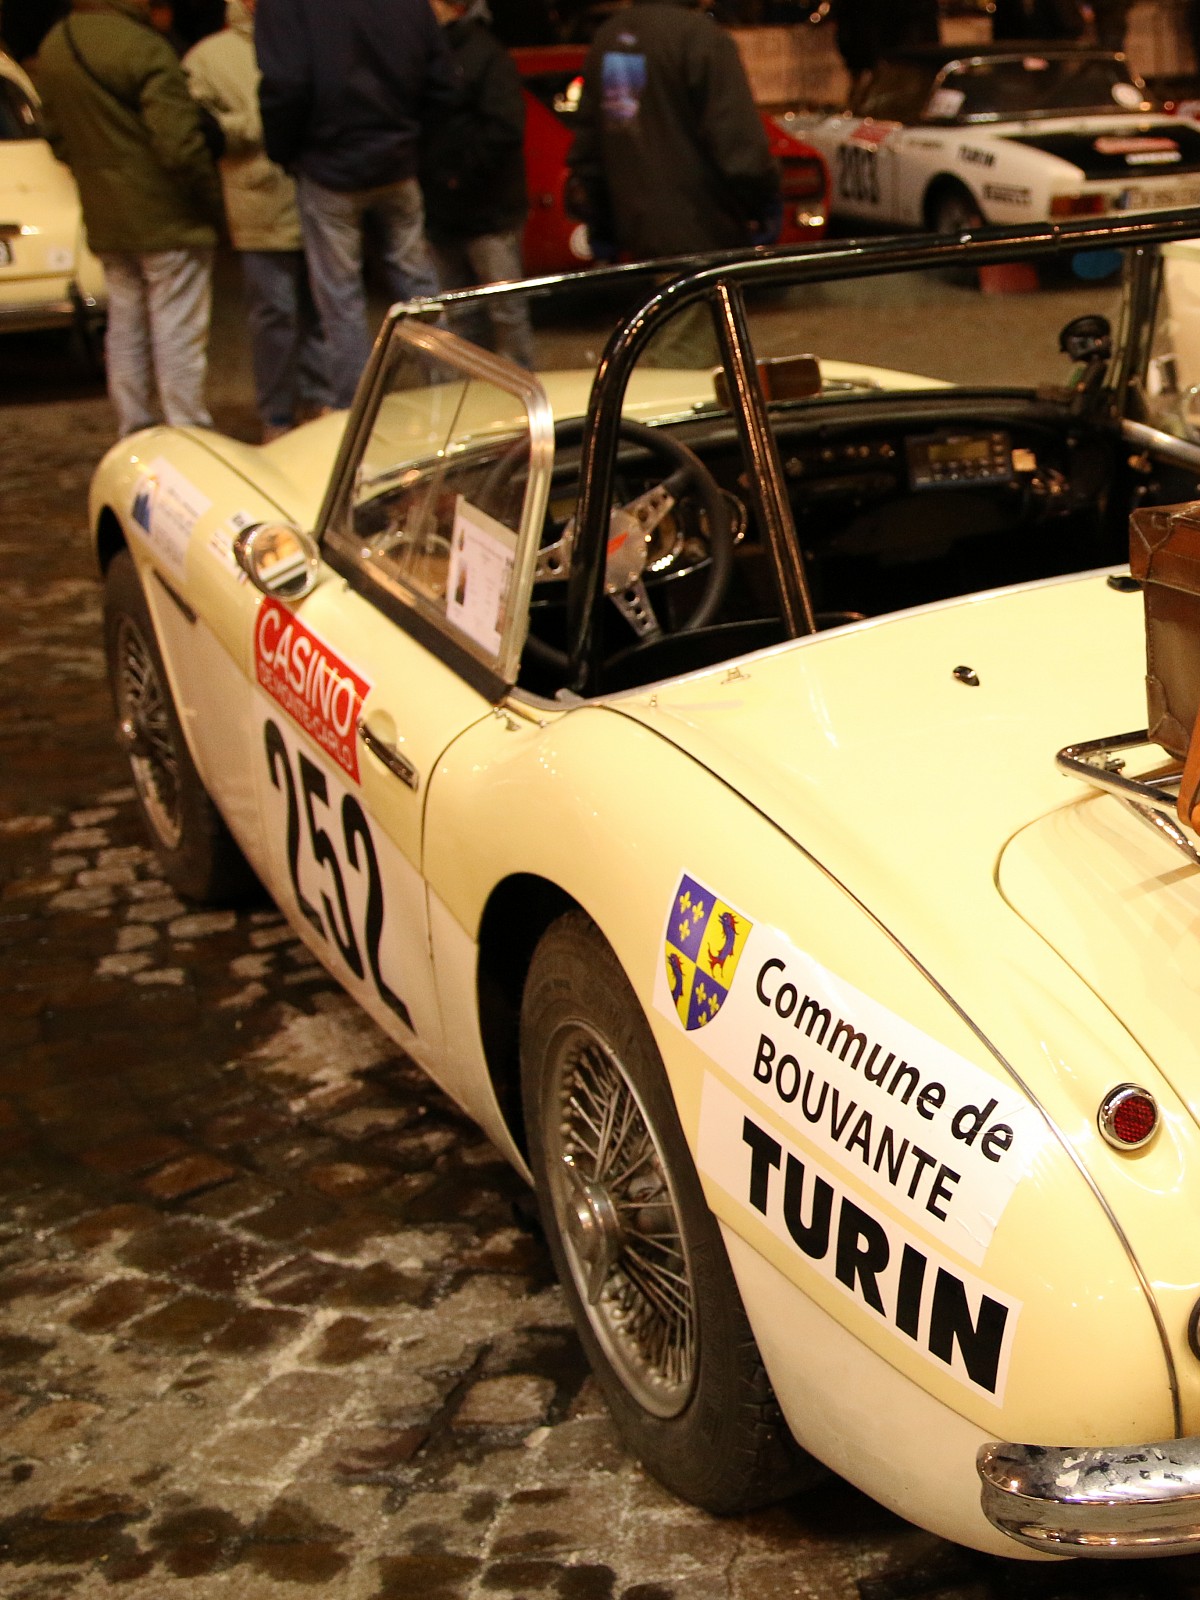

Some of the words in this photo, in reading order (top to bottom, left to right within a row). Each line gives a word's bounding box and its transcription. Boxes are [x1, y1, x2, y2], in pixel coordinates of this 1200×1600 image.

[258, 607, 356, 737] CASINO
[264, 716, 416, 1036] 252
[753, 1033, 961, 1222] BOUVANTE
[756, 957, 947, 1121] Commune
[951, 1098, 1014, 1163] de
[742, 1115, 1010, 1395] TURIN
